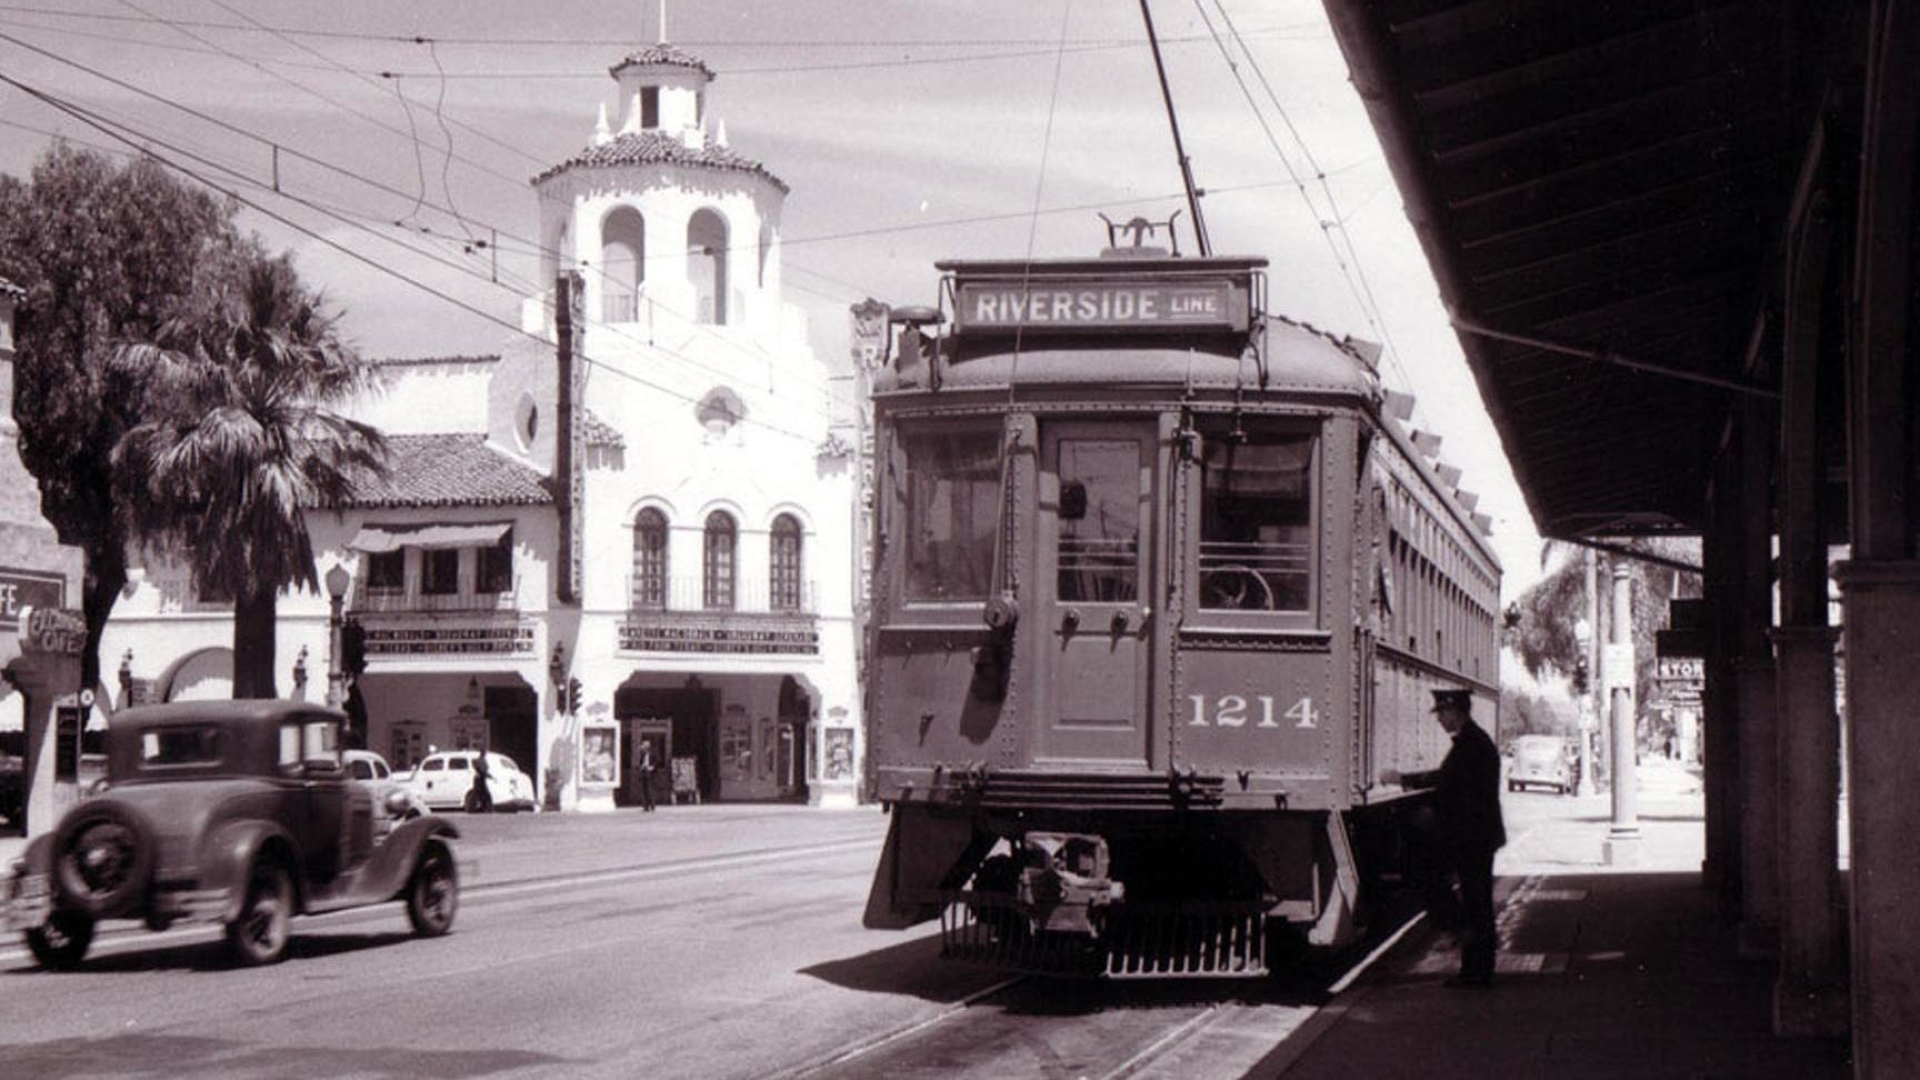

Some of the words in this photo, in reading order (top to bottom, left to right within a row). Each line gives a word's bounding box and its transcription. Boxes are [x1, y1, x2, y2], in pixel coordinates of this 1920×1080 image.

[976, 290, 1159, 321] RIVERSIDE
[1170, 296, 1217, 312] LINE
[1188, 694, 1320, 728] 1214
